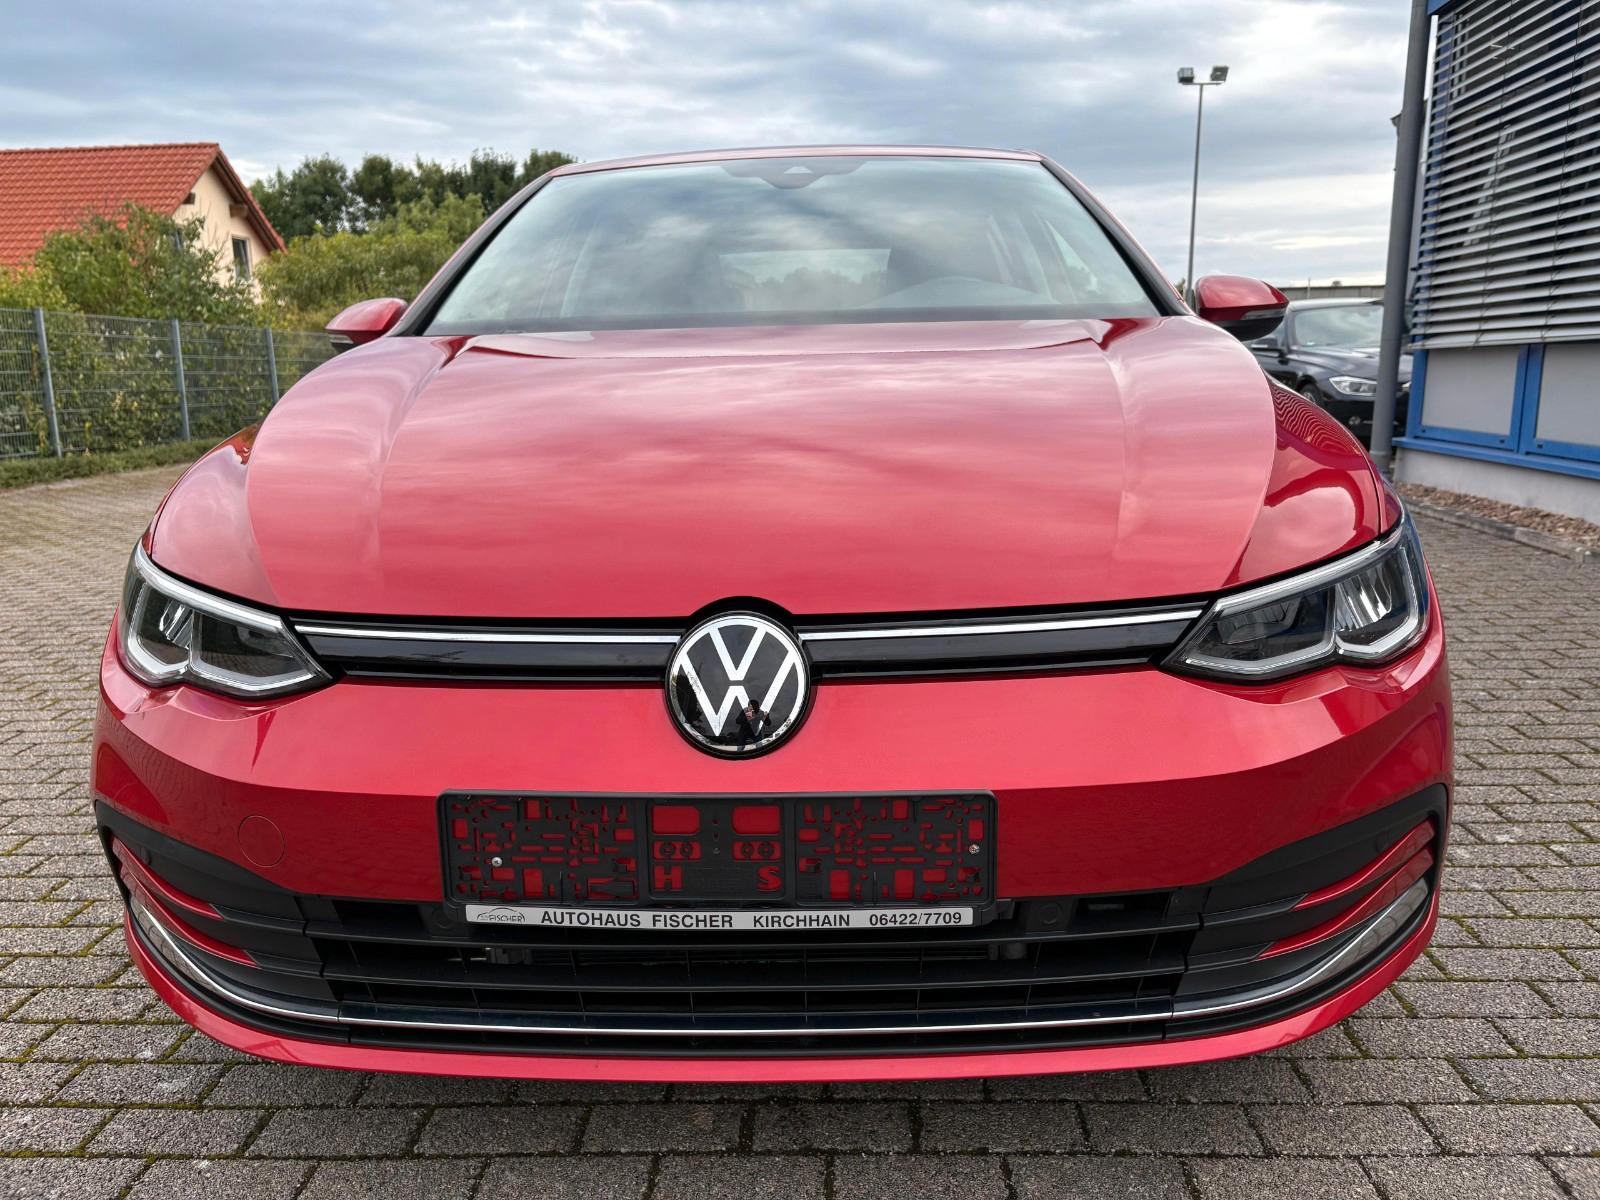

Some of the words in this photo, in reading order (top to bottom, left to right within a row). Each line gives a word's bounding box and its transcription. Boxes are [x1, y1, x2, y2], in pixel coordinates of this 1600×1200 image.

[671, 616, 806, 751] VW
[488, 914, 523, 923] FISCHER
[540, 910, 641, 928] AUTOHAUS
[652, 914, 733, 928] FISCHER
[753, 914, 850, 928] KIRCHHAIN
[869, 911, 962, 926] 06422/7709
